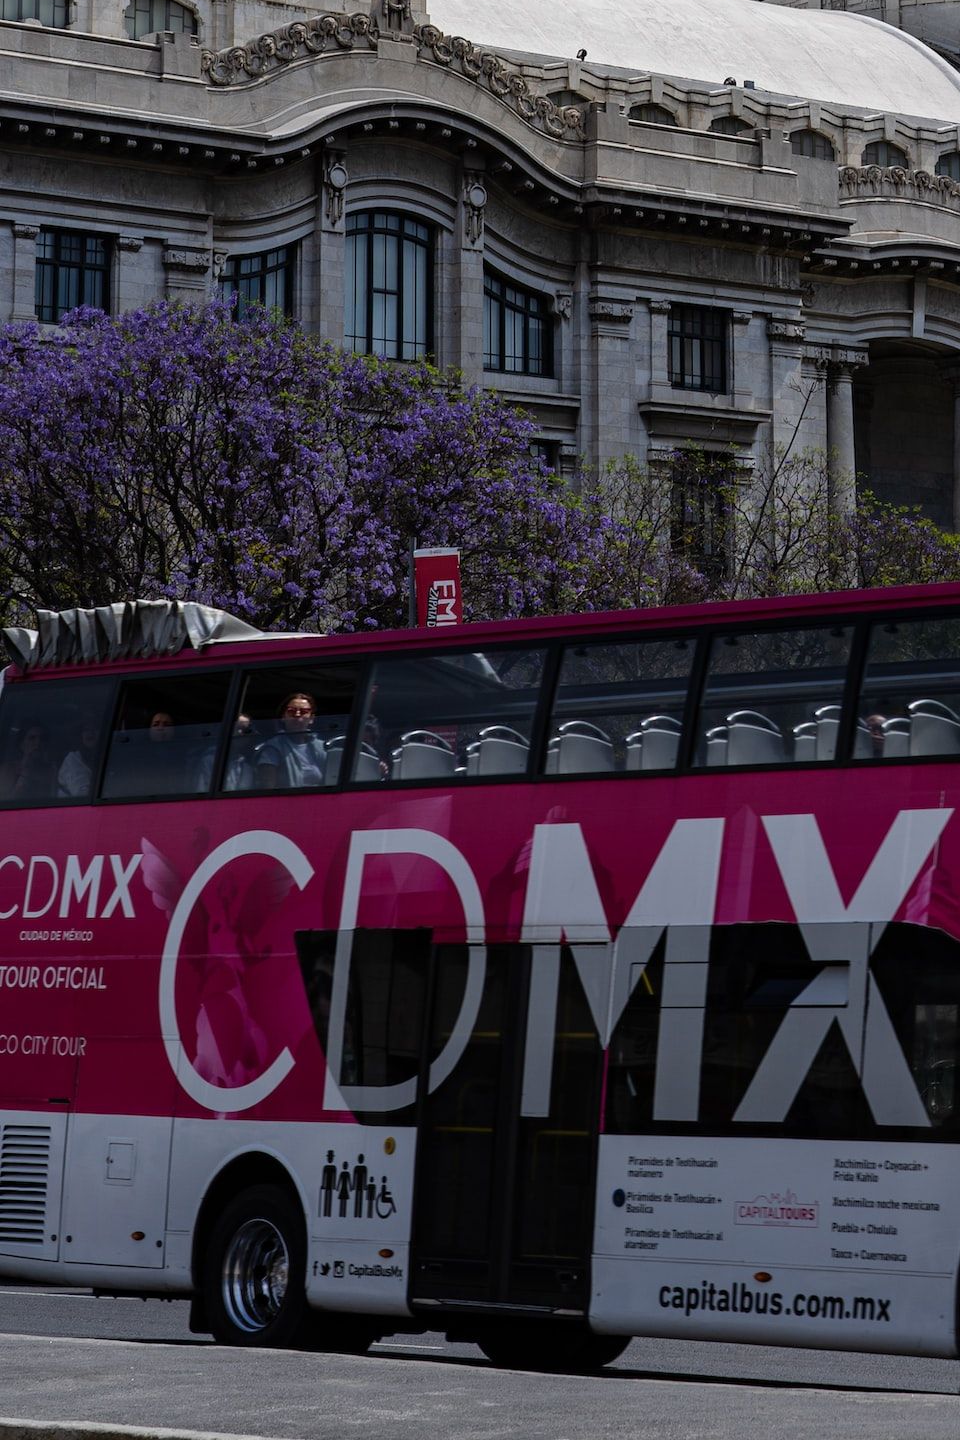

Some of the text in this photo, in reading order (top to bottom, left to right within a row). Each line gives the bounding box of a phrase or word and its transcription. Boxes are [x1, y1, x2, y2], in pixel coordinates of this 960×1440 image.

[0, 853, 144, 920] CDMX
[19, 927, 94, 942] CIUDAD DE MÉXICO
[0, 965, 108, 990] TOUR OFICIAL
[159, 807, 955, 1127] CDMX
[21, 1035, 49, 1055] CITY
[52, 1036, 87, 1056] TOUR
[738, 1205, 815, 1221] CAPITALTOURS
[658, 1280, 892, 1322] capitalbus.com.mx
